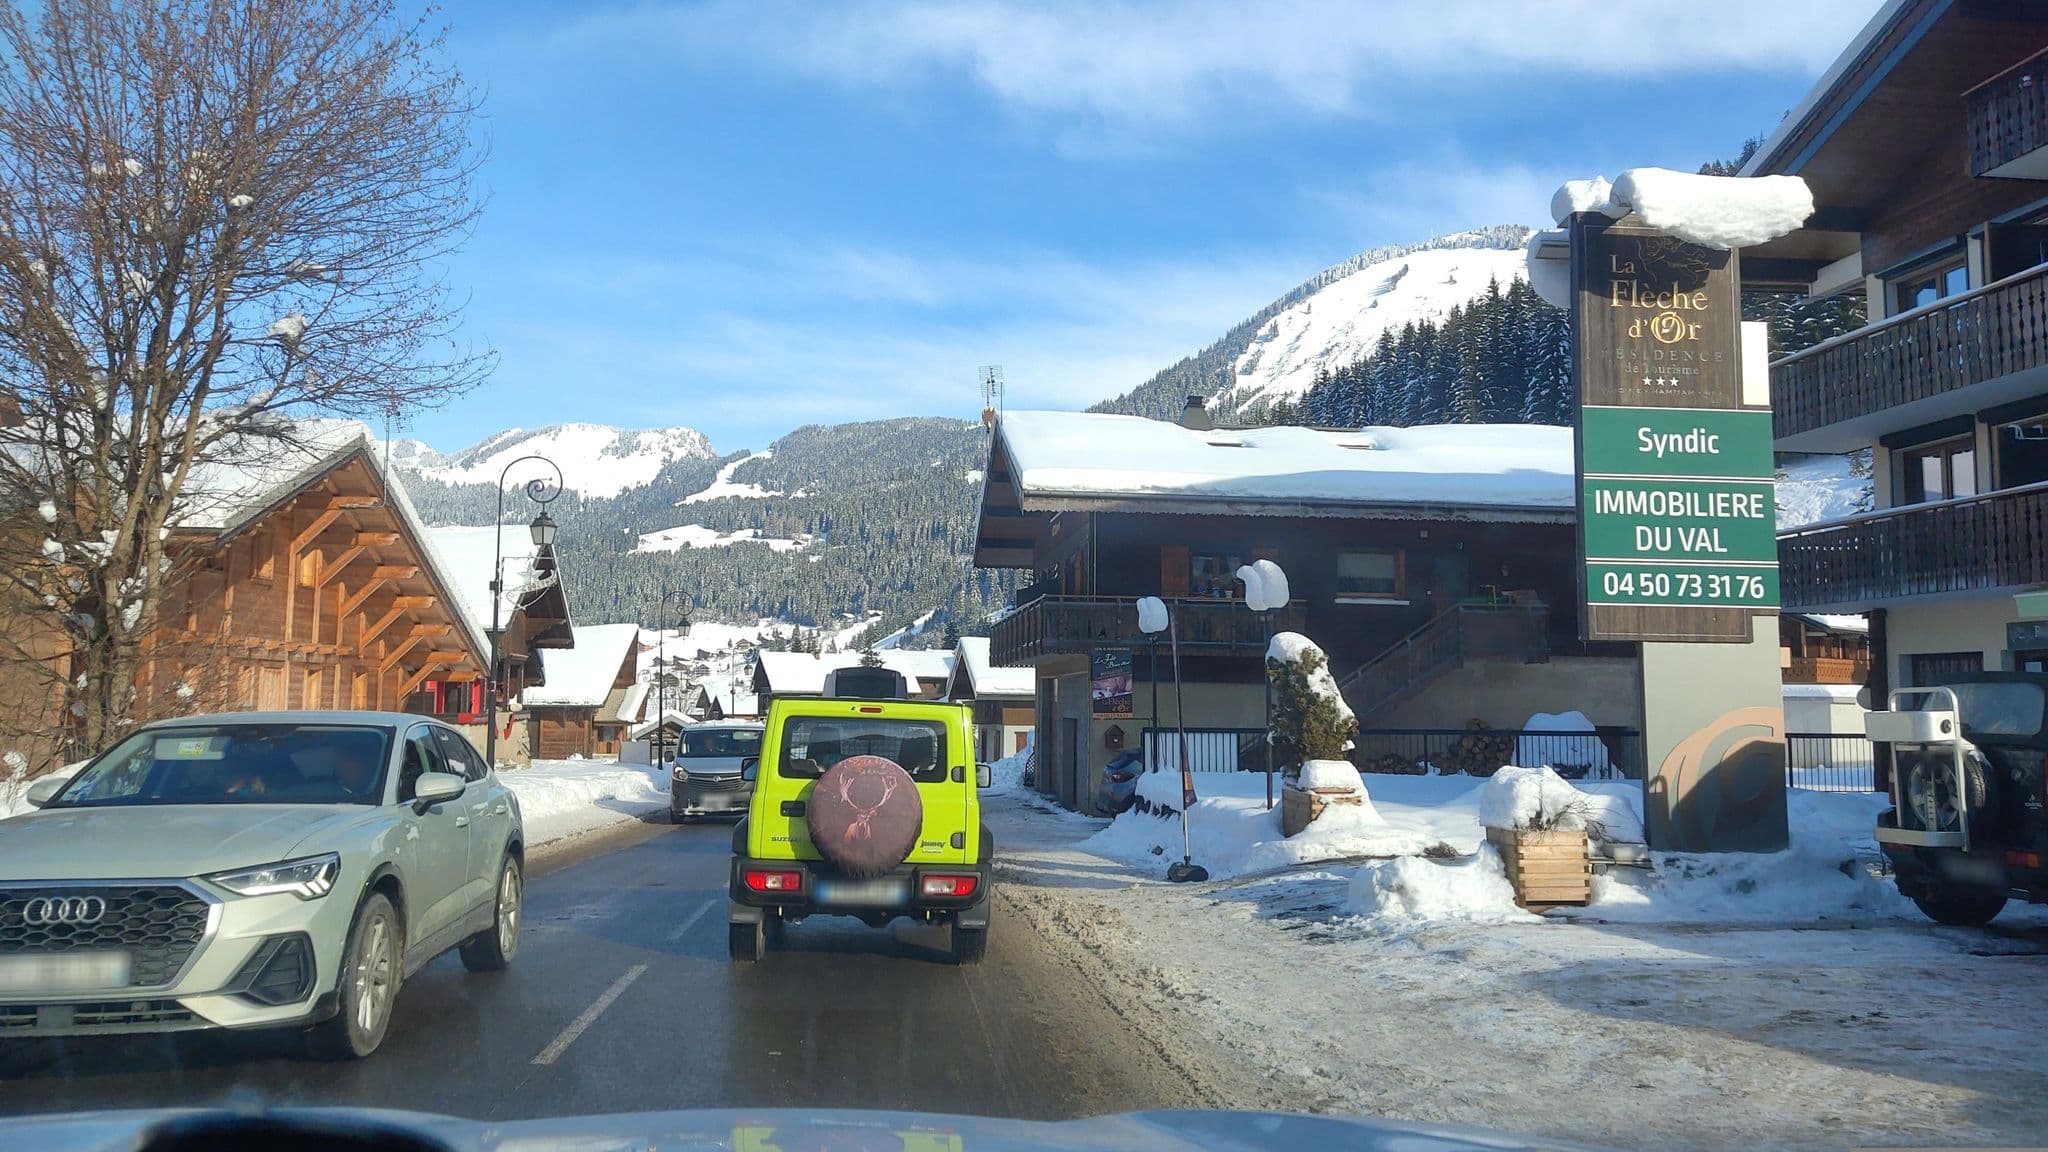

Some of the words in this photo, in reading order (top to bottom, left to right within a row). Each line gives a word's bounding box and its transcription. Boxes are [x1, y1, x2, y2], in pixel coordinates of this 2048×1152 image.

[1610, 254, 1636, 274] La
[1610, 280, 1709, 311] Flèche
[1628, 312, 1703, 344] d'Or
[1625, 362, 1640, 374] de
[1638, 427, 1719, 458] Syndic
[1595, 489, 1765, 518] IMMOBILIERE
[1635, 526, 1672, 551] DU
[1678, 527, 1728, 553] VAL
[1604, 572, 1635, 596] 04
[1640, 573, 1670, 597] 50
[1675, 574, 1702, 597] 73
[1708, 575, 1731, 598] 31
[1736, 575, 1765, 599] 76
